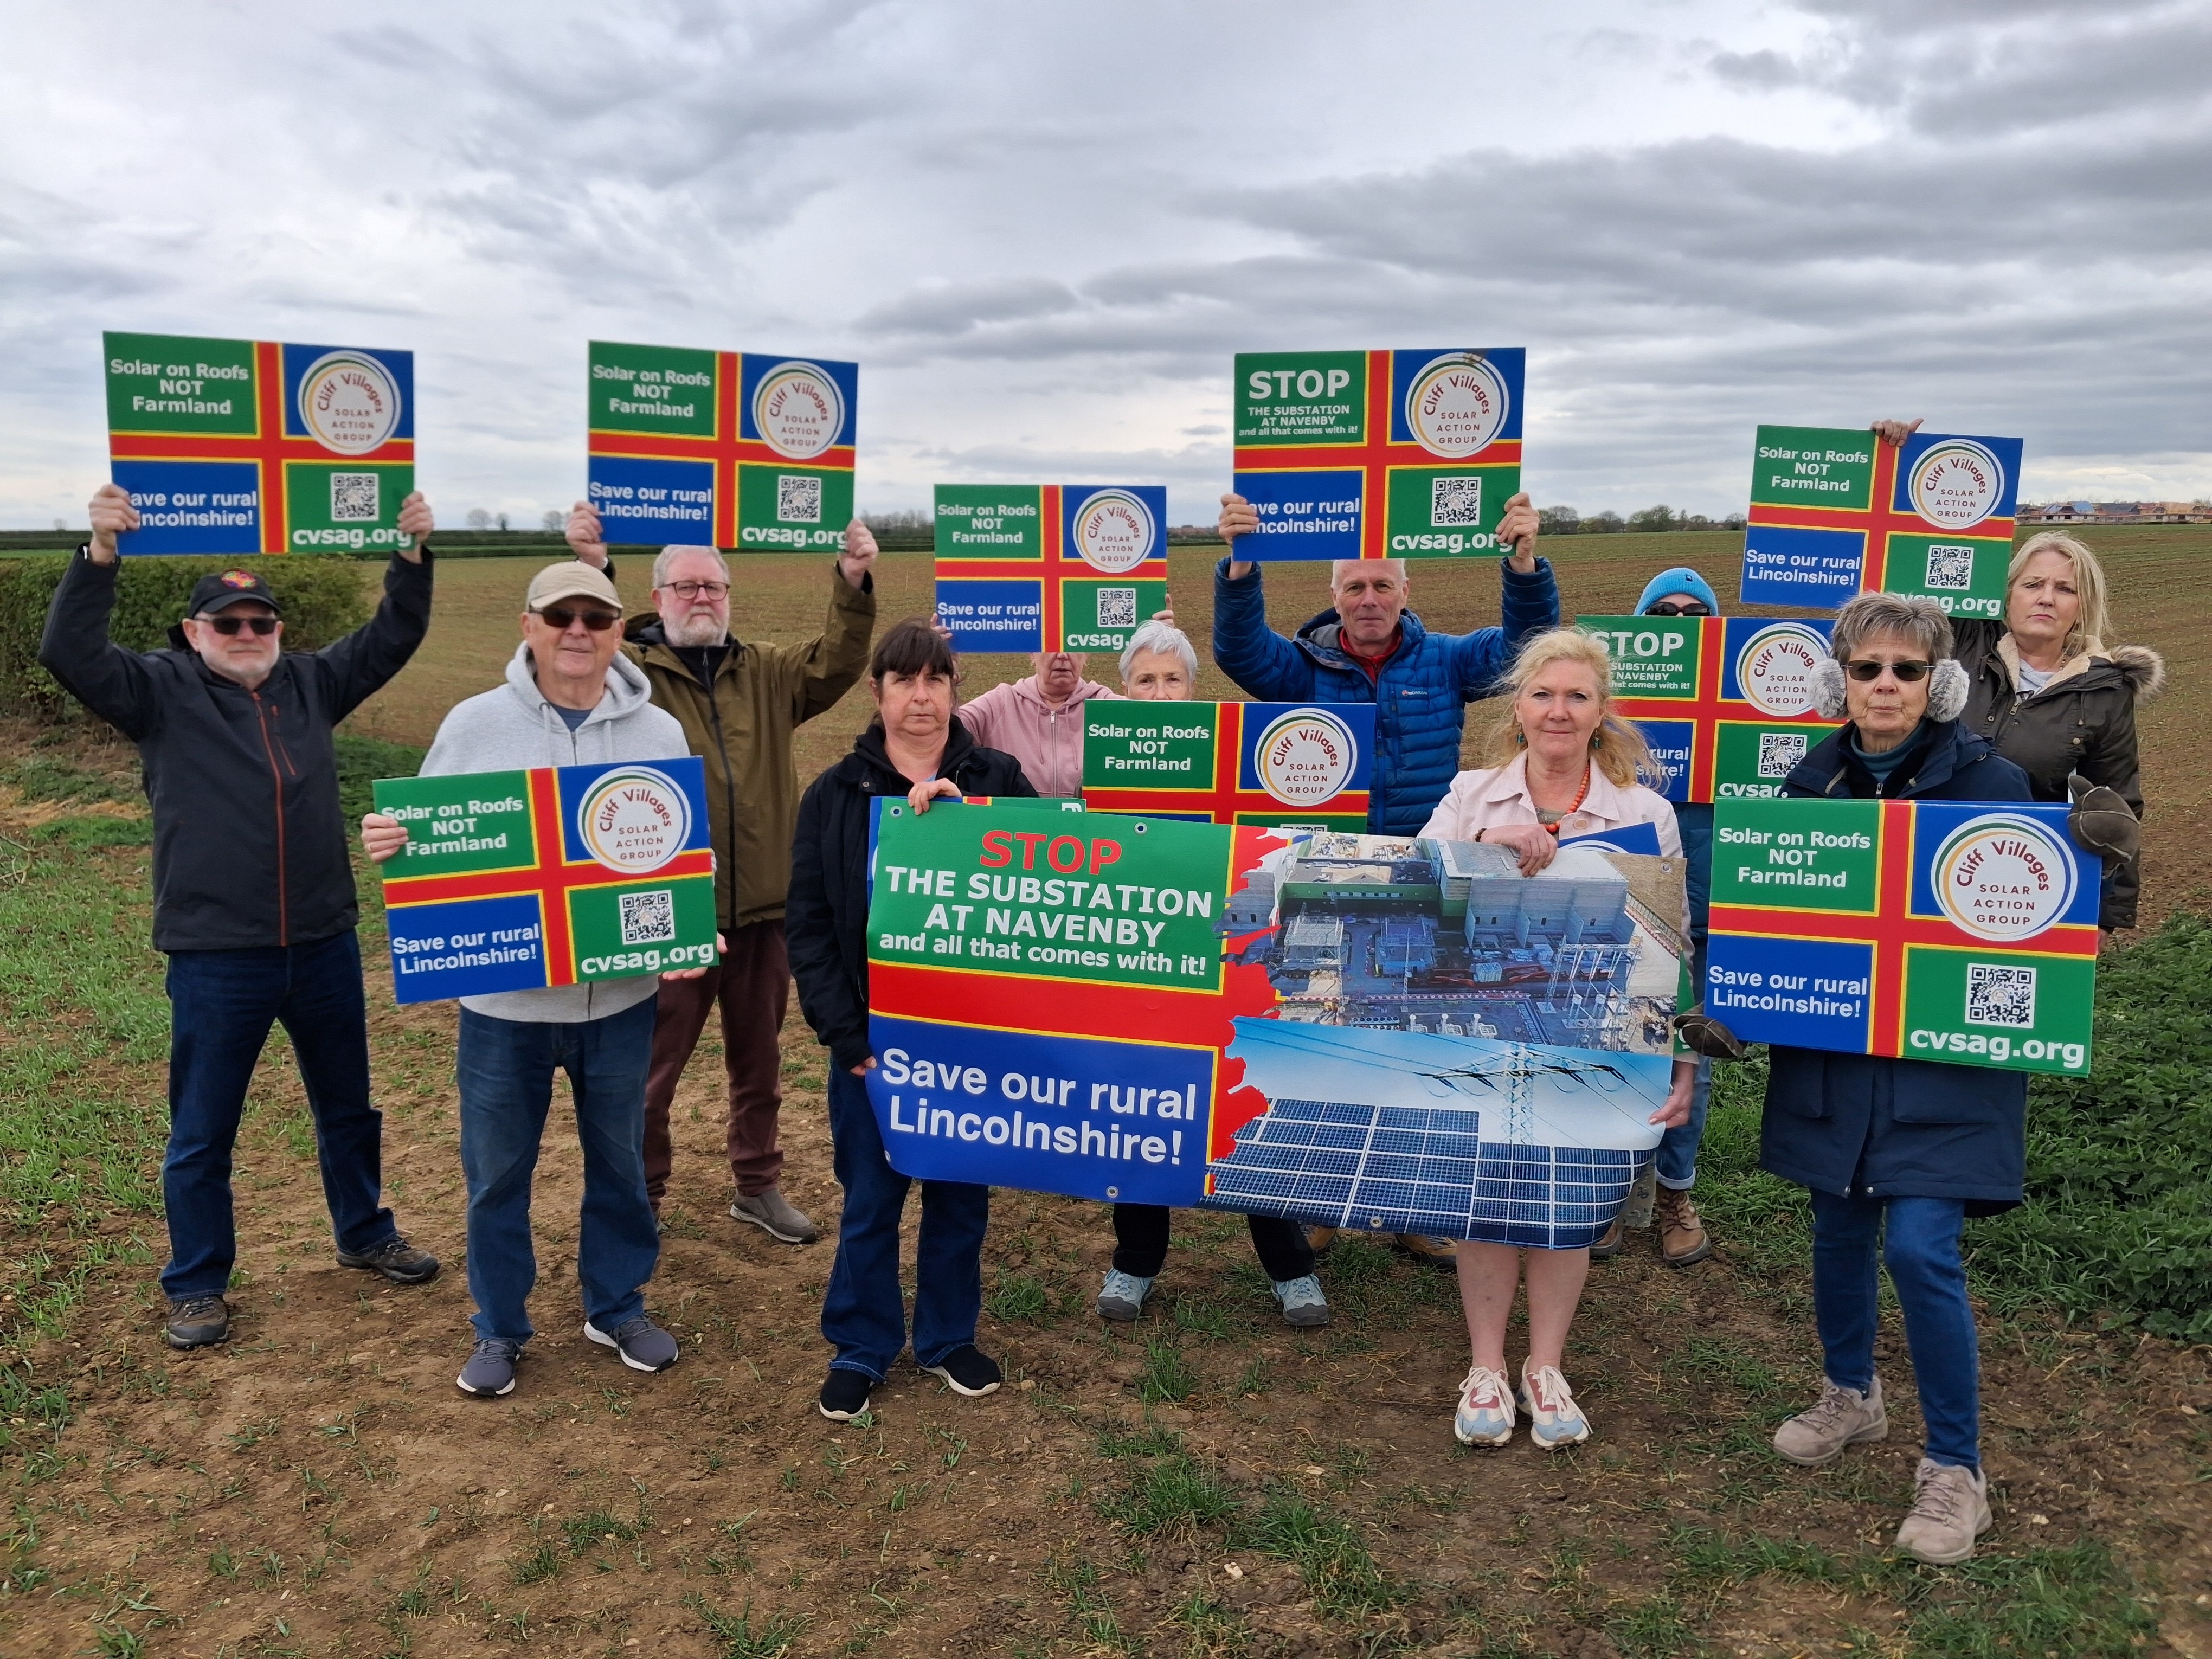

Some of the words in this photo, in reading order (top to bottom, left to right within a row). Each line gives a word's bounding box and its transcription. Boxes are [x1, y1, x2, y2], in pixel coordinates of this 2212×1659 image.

[110, 358, 162, 376] Solar
[166, 364, 190, 377] on
[196, 363, 249, 381] Roofs
[593, 364, 636, 381] Solar
[639, 370, 661, 383] on
[665, 370, 711, 387] Roofs
[160, 379, 204, 396] NOT
[633, 383, 672, 400] NOT
[1249, 369, 1350, 400] STOP
[1423, 386, 1444, 415] Cliff
[1448, 375, 1490, 414] Villages
[133, 396, 232, 415] Farmland
[609, 398, 694, 417] Farmland
[1248, 407, 1271, 416] THE
[1274, 404, 1350, 416] SUBSTATION
[1261, 417, 1277, 427] AT
[1280, 416, 1336, 426] NAVENBY
[1440, 411, 1476, 420] SOLAR
[1238, 427, 1257, 436] and
[1258, 427, 1270, 435] all
[1271, 427, 1291, 435] that
[1347, 425, 1358, 433] it!
[1437, 423, 1480, 432] ACTION
[1439, 436, 1477, 445] GROUP
[1759, 446, 1798, 459] Solar
[1802, 451, 1821, 461] on
[1825, 450, 1868, 464] Roofs
[1795, 462, 1830, 475] NOT
[1926, 464, 1946, 491] Cliff
[1950, 458, 1986, 494] Villages
[1771, 475, 1850, 492] Farmland
[130, 491, 167, 506] ave
[172, 493, 207, 507] our
[212, 490, 258, 507] rural
[589, 483, 633, 499] Save
[638, 487, 667, 500] our
[672, 488, 712, 503] rural
[1940, 488, 1973, 497] SOLAR
[937, 504, 974, 516] Solar
[976, 506, 994, 516] on
[998, 504, 1037, 516] Roofs
[1283, 500, 1313, 515] our
[1319, 498, 1360, 513] rural
[1935, 499, 1976, 508] ACTION
[142, 510, 253, 526] ncolnshire!
[1088, 513, 1103, 538] Cliff
[1107, 506, 1140, 539] Villages
[1937, 510, 1973, 518] GROUP
[972, 518, 1004, 530] NOT
[1251, 518, 1355, 535] ncolnshire!
[293, 529, 411, 549] cvsag.org
[952, 531, 1023, 543] Farmland
[1746, 549, 1786, 565] Save
[1790, 555, 1818, 567] our
[1822, 556, 1861, 570] rural
[1748, 566, 1855, 586] Lincolnshire!
[937, 602, 974, 615] Save
[977, 605, 1002, 615] our
[1006, 602, 1040, 615] rural
[942, 619, 1037, 631] Lincolnshire!
[1066, 634, 1129, 649] cvsag.
[1587, 632, 1684, 657] STOP
[1610, 663, 1683, 672] SUBSTATION
[1754, 648, 1774, 677] Cliff
[1778, 642, 1815, 671] Villag
[1616, 672, 1669, 680] NAVENBY
[1088, 724, 1133, 737] Solar
[1136, 728, 1157, 738] on
[1162, 725, 1210, 739] Roofs
[1129, 741, 1168, 754] NOT
[1272, 736, 1294, 766] Cliff
[1297, 729, 1338, 767] Villages
[1649, 747, 1689, 760] rural
[1105, 756, 1191, 771] Farmland
[382, 805, 433, 821] Solar
[438, 804, 463, 817] on
[468, 796, 524, 815] Roofs
[599, 799, 620, 832] Cliff
[622, 789, 671, 827] Villages
[432, 818, 478, 835] NOT
[618, 824, 658, 835] SOLAR
[405, 833, 506, 857] Farmland
[616, 837, 663, 848] ACTION
[1719, 827, 1773, 844] Solar
[1777, 832, 1804, 846] on
[1810, 831, 1870, 848] Roofs
[620, 850, 662, 860] GROUP
[979, 829, 1122, 875] STOP
[1769, 848, 1818, 866] NOT
[1957, 848, 1985, 888] Cliff
[1991, 840, 2049, 891] Villages
[1738, 866, 1847, 888] Farmland
[885, 865, 956, 897] THE
[967, 873, 1212, 918] SUBSTATION
[1979, 884, 2030, 895] SOLAR
[1973, 899, 2035, 910] ACTION
[924, 903, 974, 931] AT
[985, 908, 1166, 947] NAVENBY
[1976, 915, 2030, 925] GROUP
[393, 937, 445, 954] Save
[450, 932, 486, 948] our
[492, 923, 539, 944] rural
[400, 943, 537, 974] Lincolnshire!
[581, 943, 714, 974] cvsag.org
[879, 932, 926, 951] and
[933, 935, 962, 955] all
[969, 937, 1021, 960] that
[1028, 946, 1109, 967] comes
[1116, 950, 1172, 973] with
[1180, 954, 1206, 975] it!
[1709, 966, 1763, 987] Save
[1769, 974, 1808, 990] our
[1814, 978, 1867, 995] rural
[1713, 988, 1861, 1018] Lincolnshire!
[1910, 1030, 2085, 1069] cvsag.org
[882, 1047, 987, 1095] Save
[1001, 1072, 1076, 1107] our
[1090, 1083, 1196, 1120] rural
[890, 1095, 1182, 1165] Lincolnshire!
